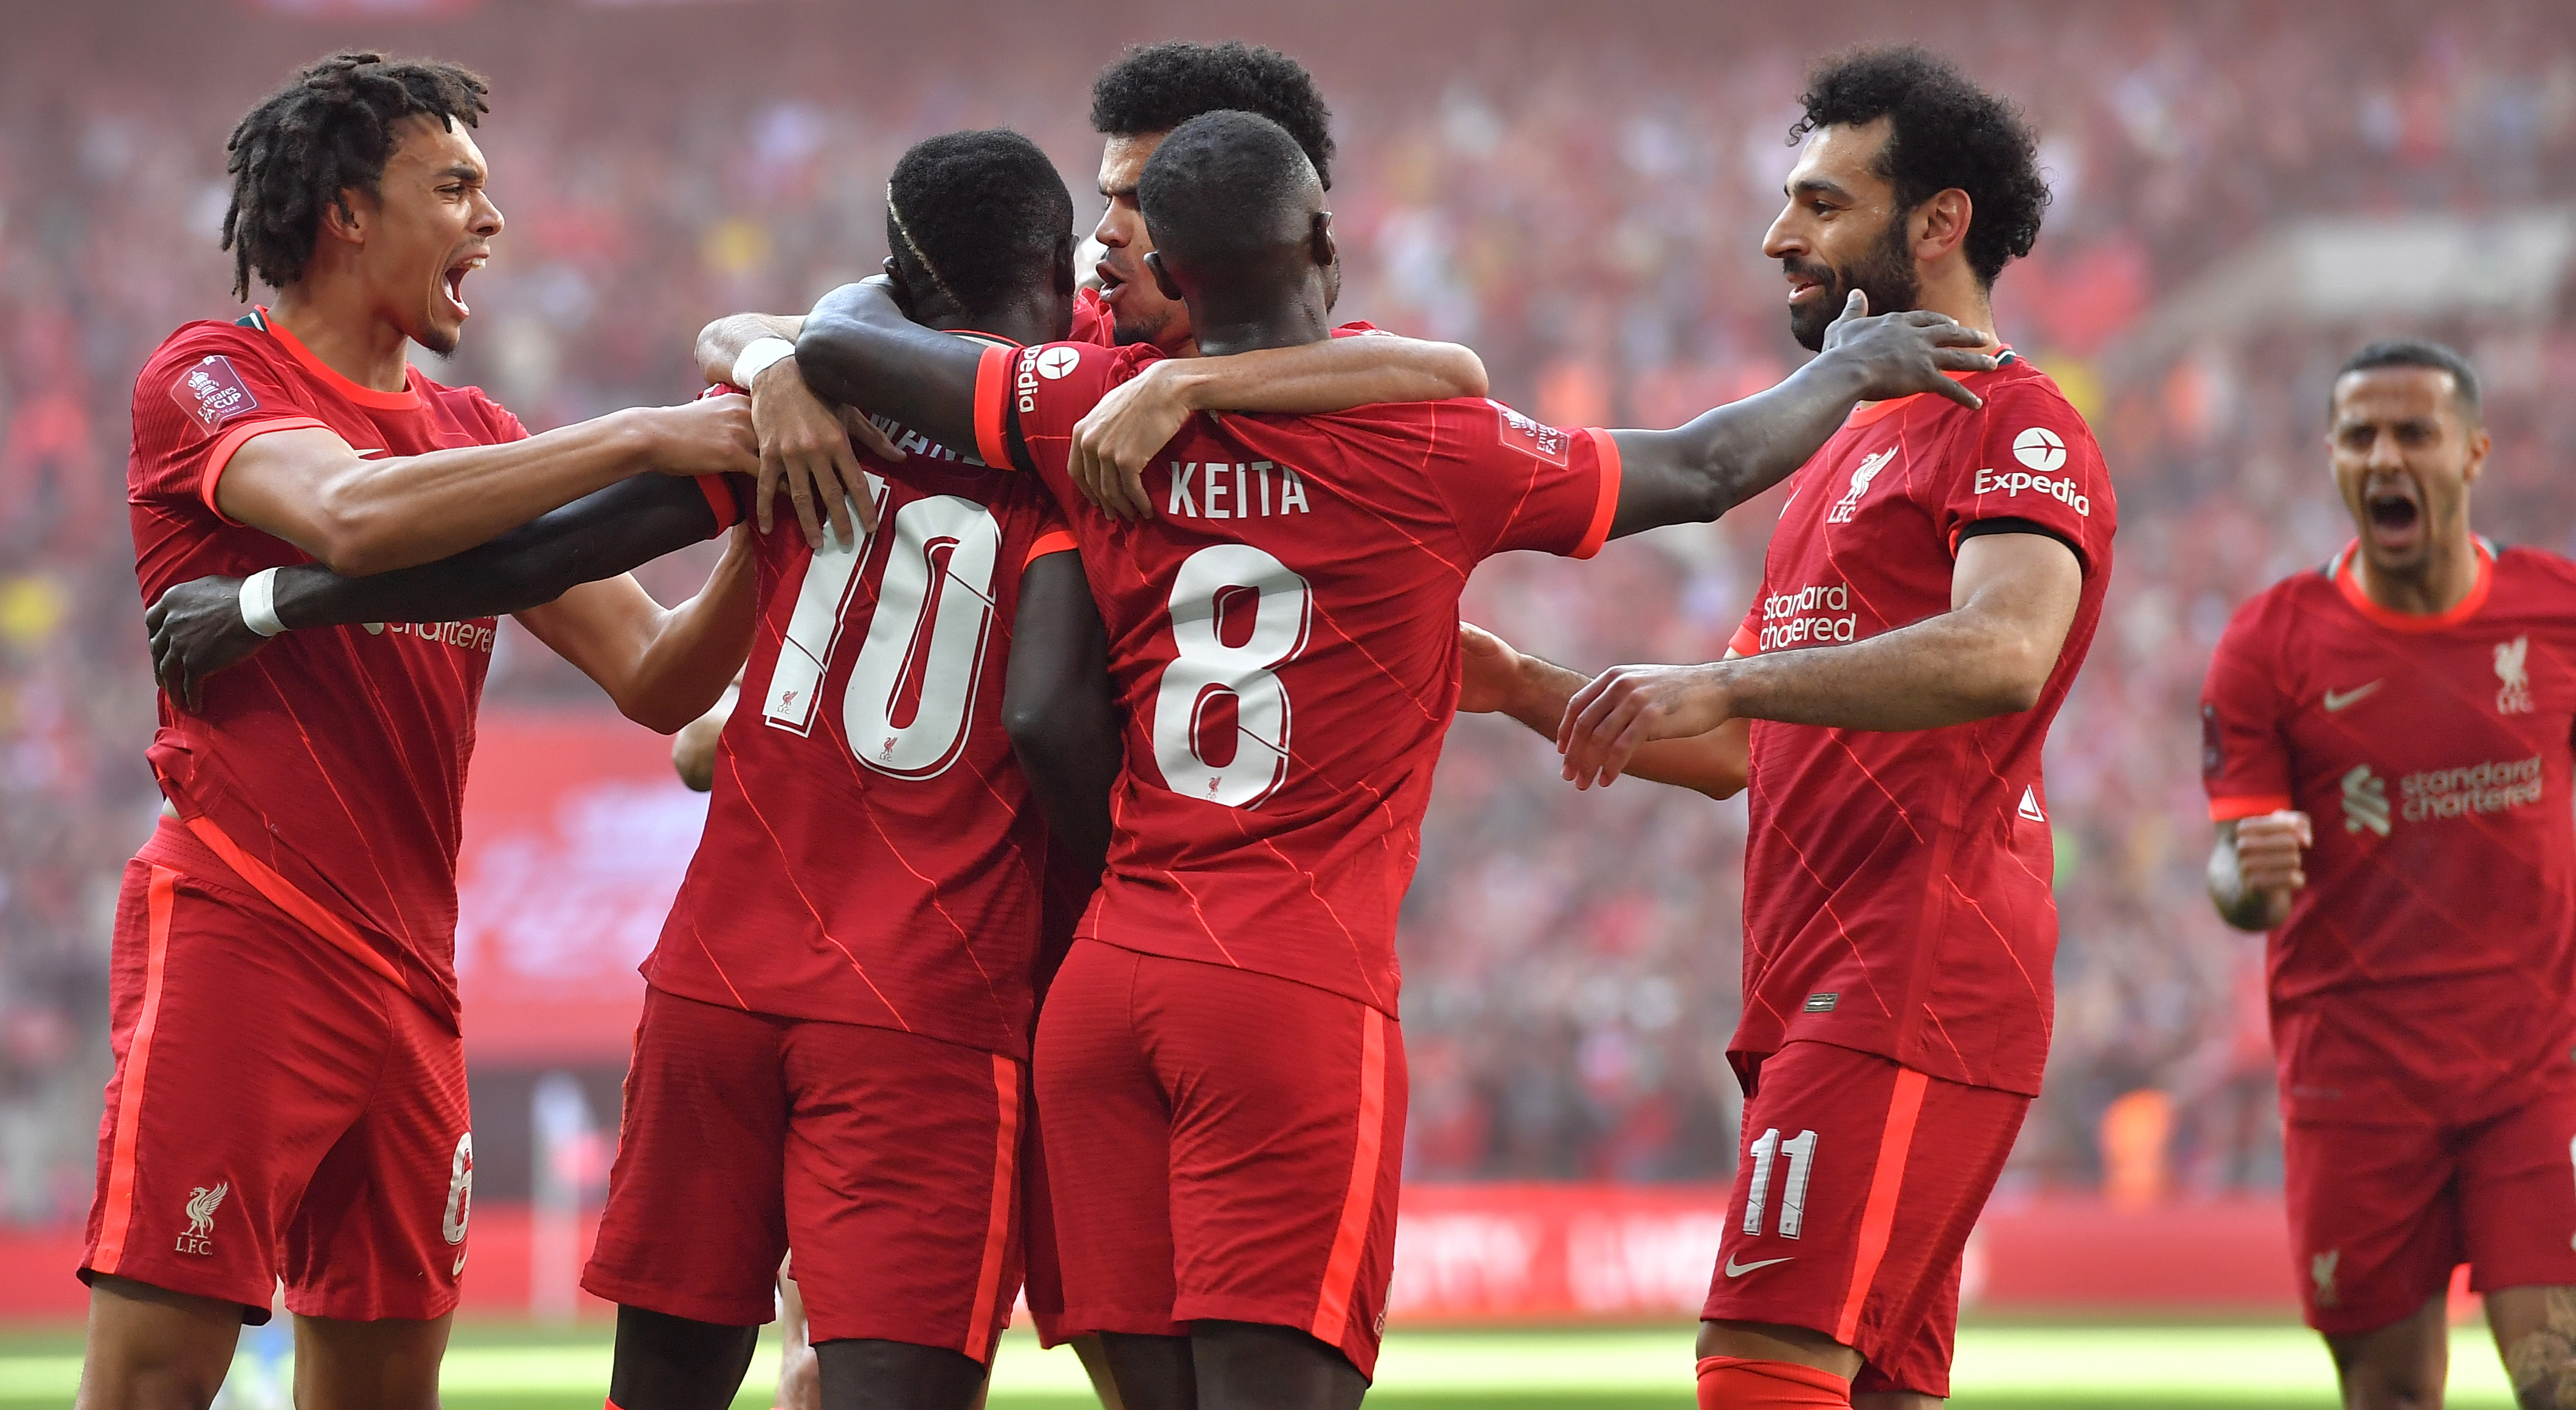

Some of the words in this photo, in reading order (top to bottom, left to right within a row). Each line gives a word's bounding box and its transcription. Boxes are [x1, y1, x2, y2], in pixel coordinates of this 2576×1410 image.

[198, 385, 238, 417] Emirates
[1017, 344, 1044, 413] pedia
[204, 408, 216, 424] FA
[213, 392, 242, 409] CUP
[1168, 460, 1310, 519] KEITA
[1974, 468, 2090, 517] Expedia
[1826, 505, 1857, 524] LFC
[762, 471, 1002, 781] 10
[1153, 544, 1313, 811] 8
[2401, 754, 2542, 796] standard
[2403, 777, 2543, 822] chartered
[1742, 1128, 1818, 1240] 11
[175, 1236, 213, 1256] L.F.C.
